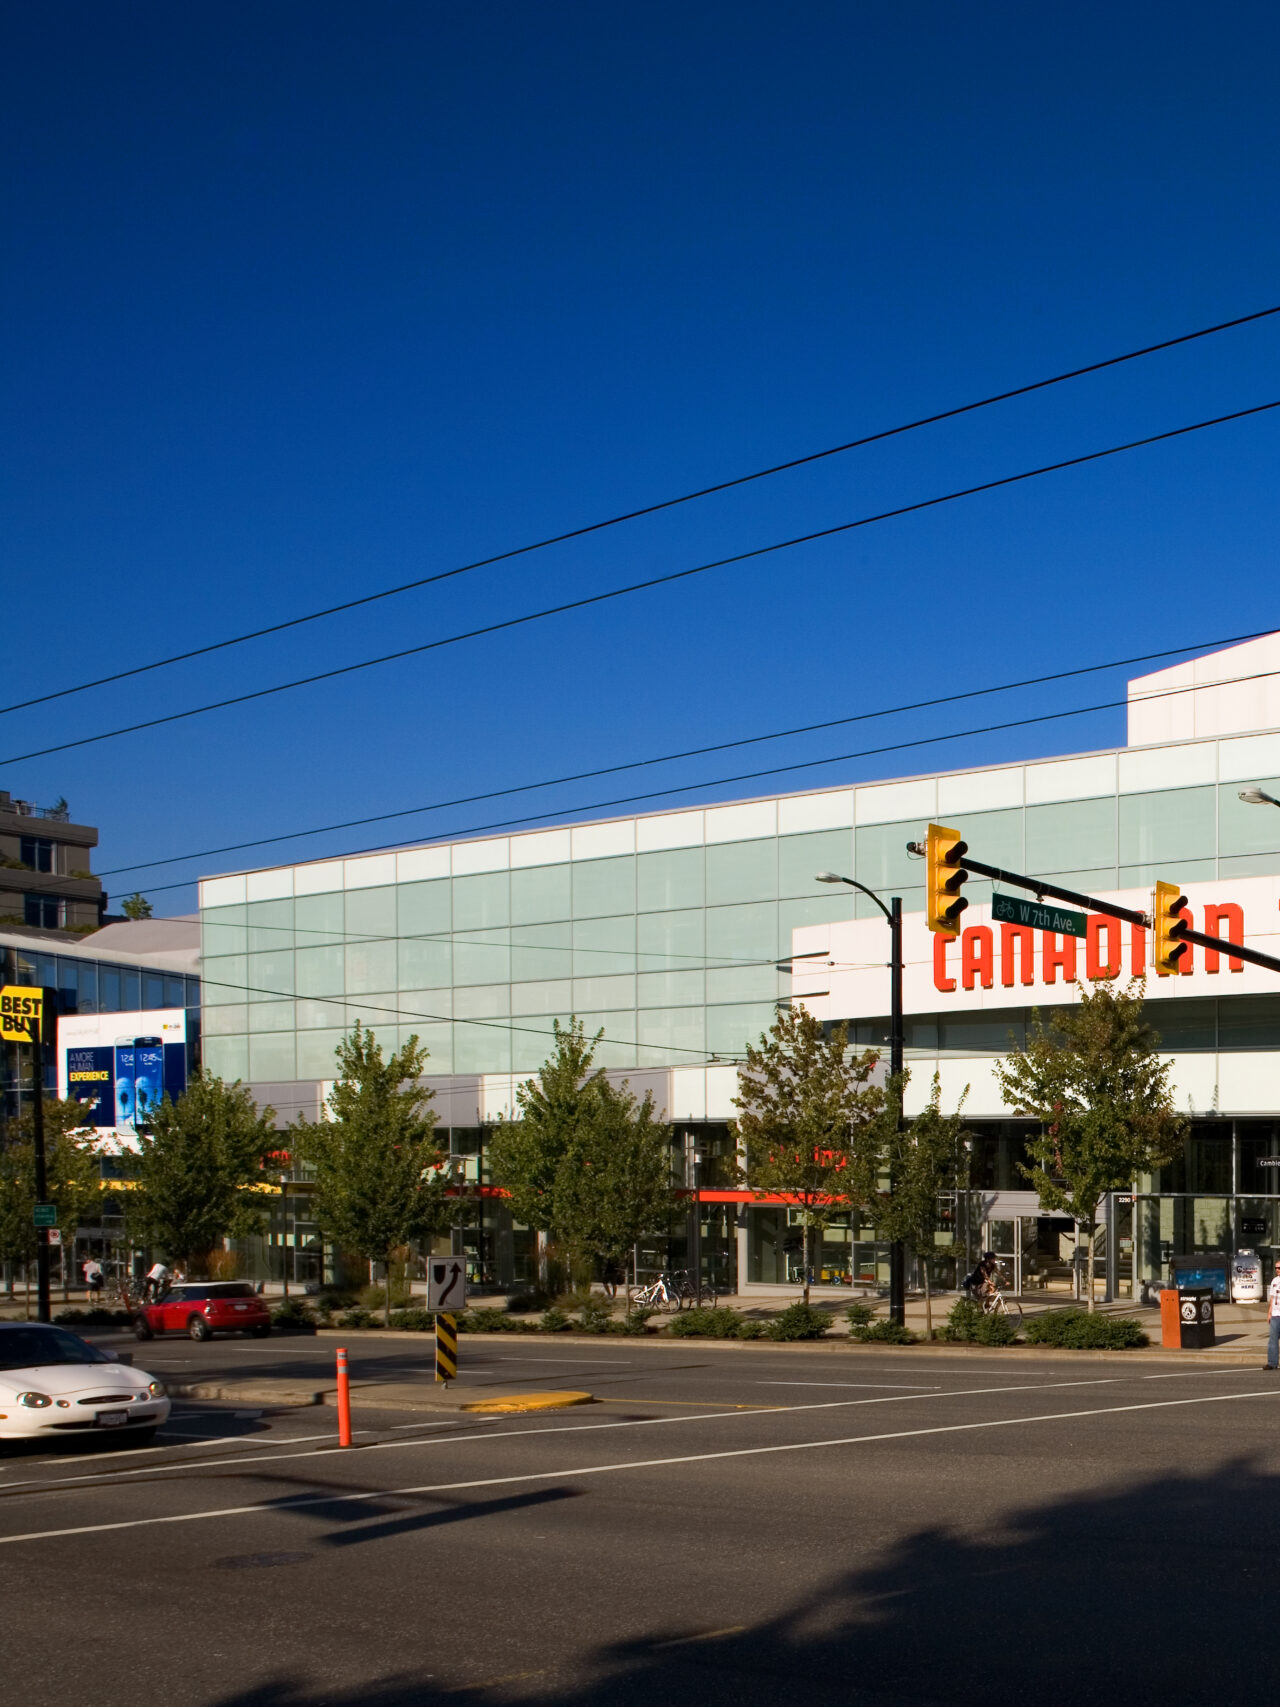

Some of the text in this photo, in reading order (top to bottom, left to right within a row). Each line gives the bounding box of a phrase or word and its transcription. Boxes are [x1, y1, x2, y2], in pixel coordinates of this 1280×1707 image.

[1019, 904, 1076, 932] W 7th Ave.
[1, 995, 42, 1016] BEST
[3, 1014, 40, 1034] BUY
[69, 1071, 109, 1081] EXPERIENCE
